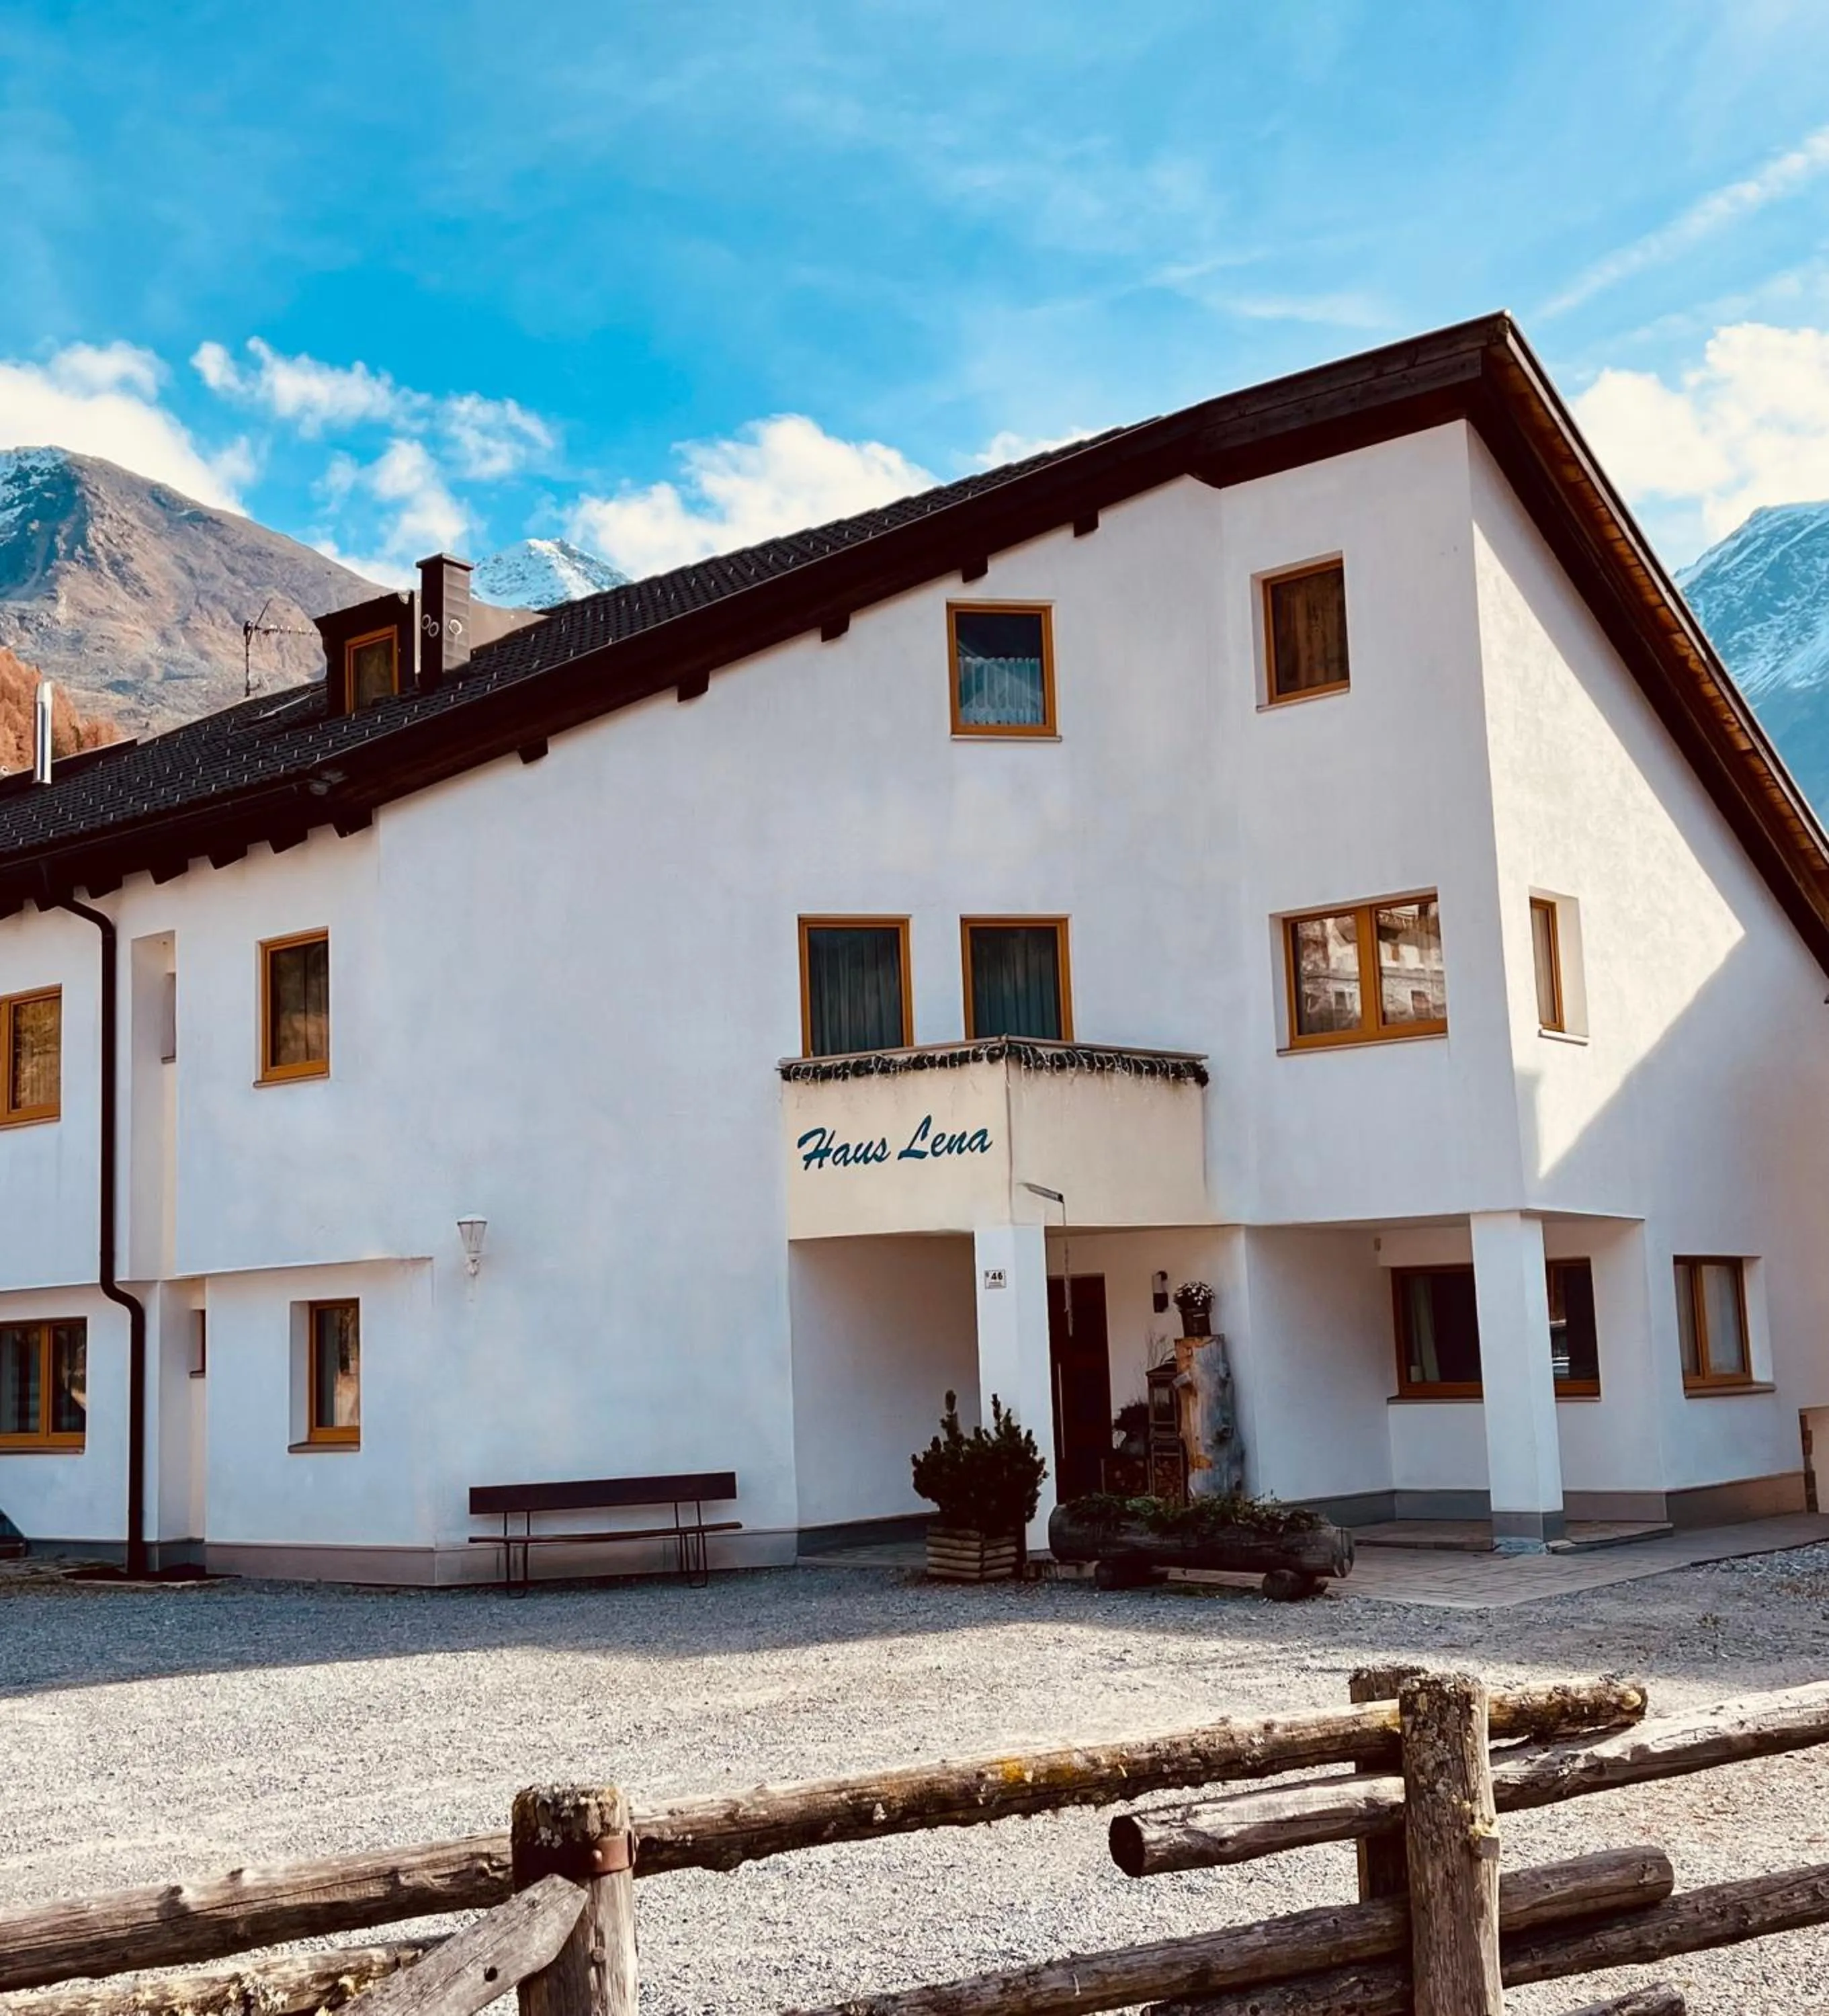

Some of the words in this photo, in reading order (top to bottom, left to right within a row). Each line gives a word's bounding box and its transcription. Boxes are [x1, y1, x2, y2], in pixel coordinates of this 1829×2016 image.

[797, 1127, 891, 1171] Haus
[897, 1114, 993, 1161] Lena
[991, 1272, 1003, 1280] 46
